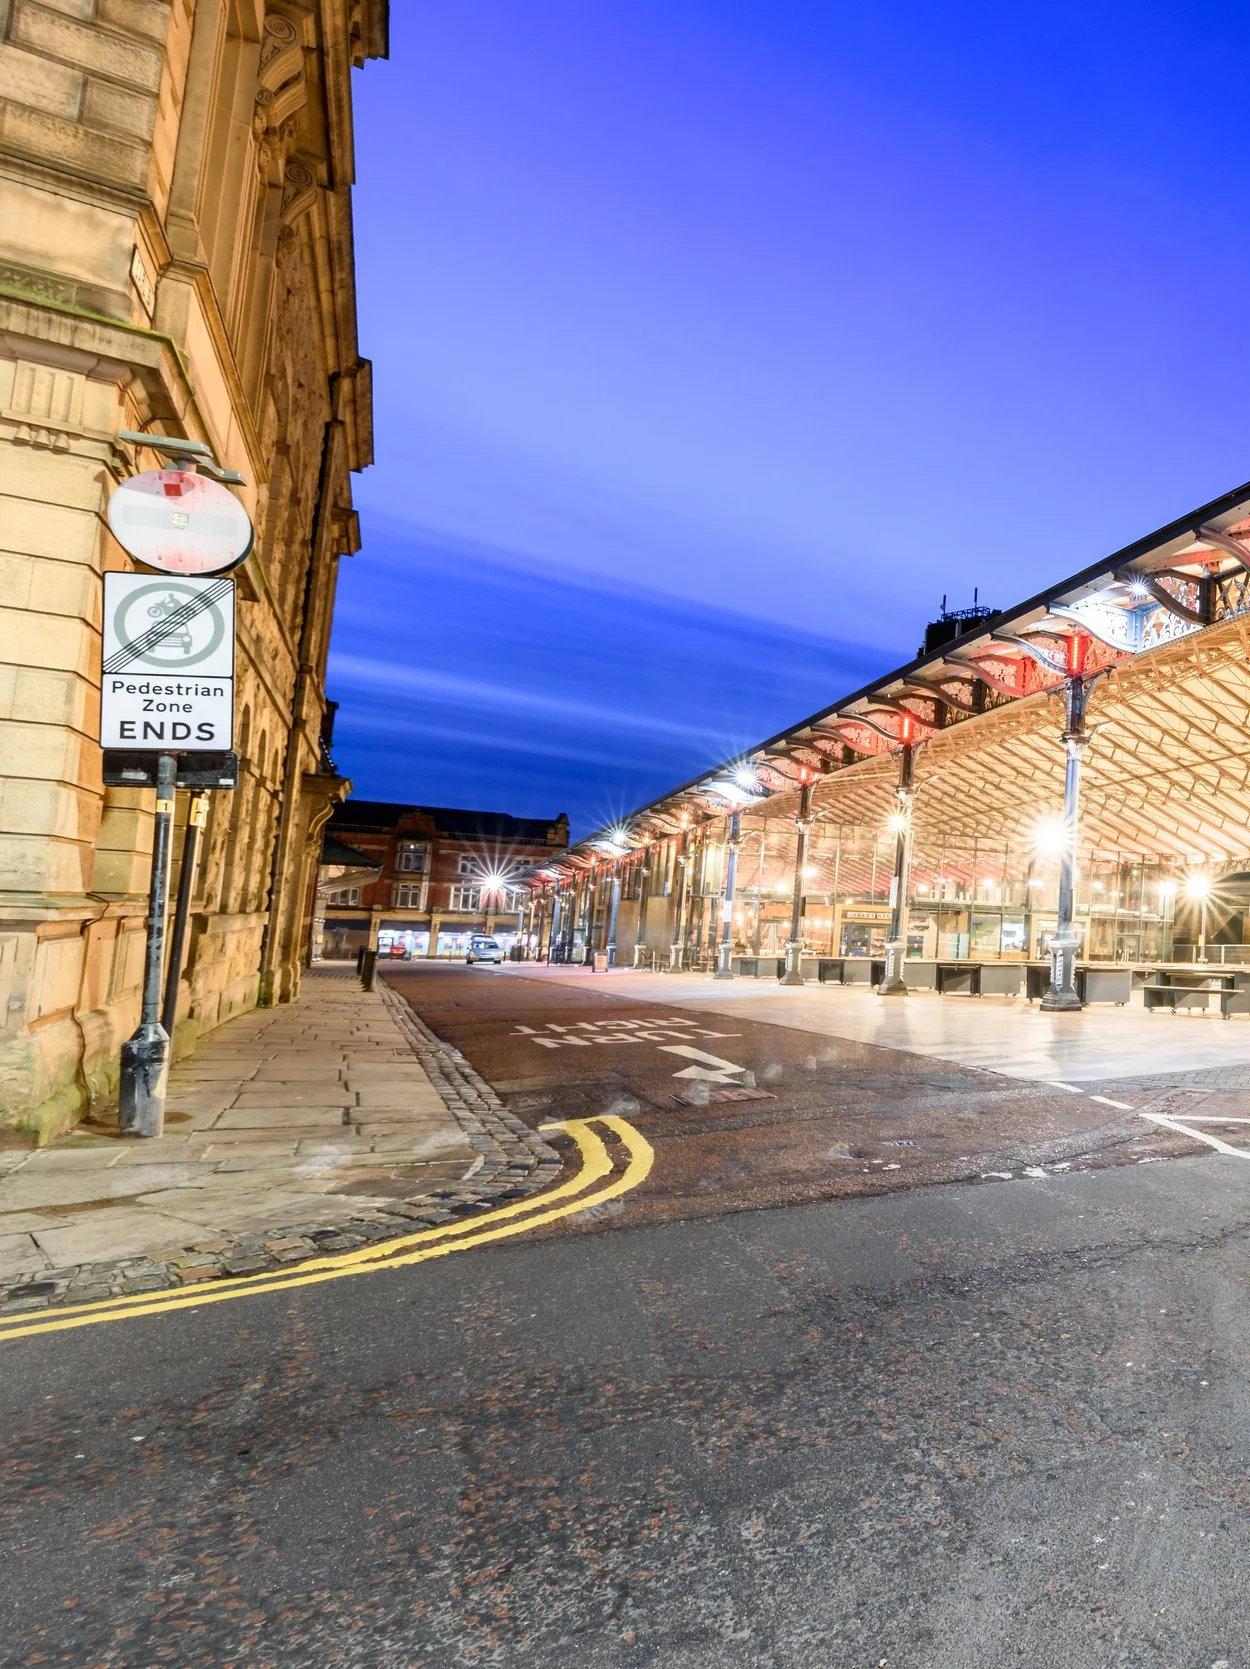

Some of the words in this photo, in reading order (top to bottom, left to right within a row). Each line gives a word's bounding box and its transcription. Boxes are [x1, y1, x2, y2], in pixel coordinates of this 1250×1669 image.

[112, 680, 224, 697] Pedestrian
[142, 699, 193, 713] Zone
[119, 720, 216, 742] ENDS
[509, 1017, 700, 1035] RIGHT
[531, 1028, 743, 1048] TURN
